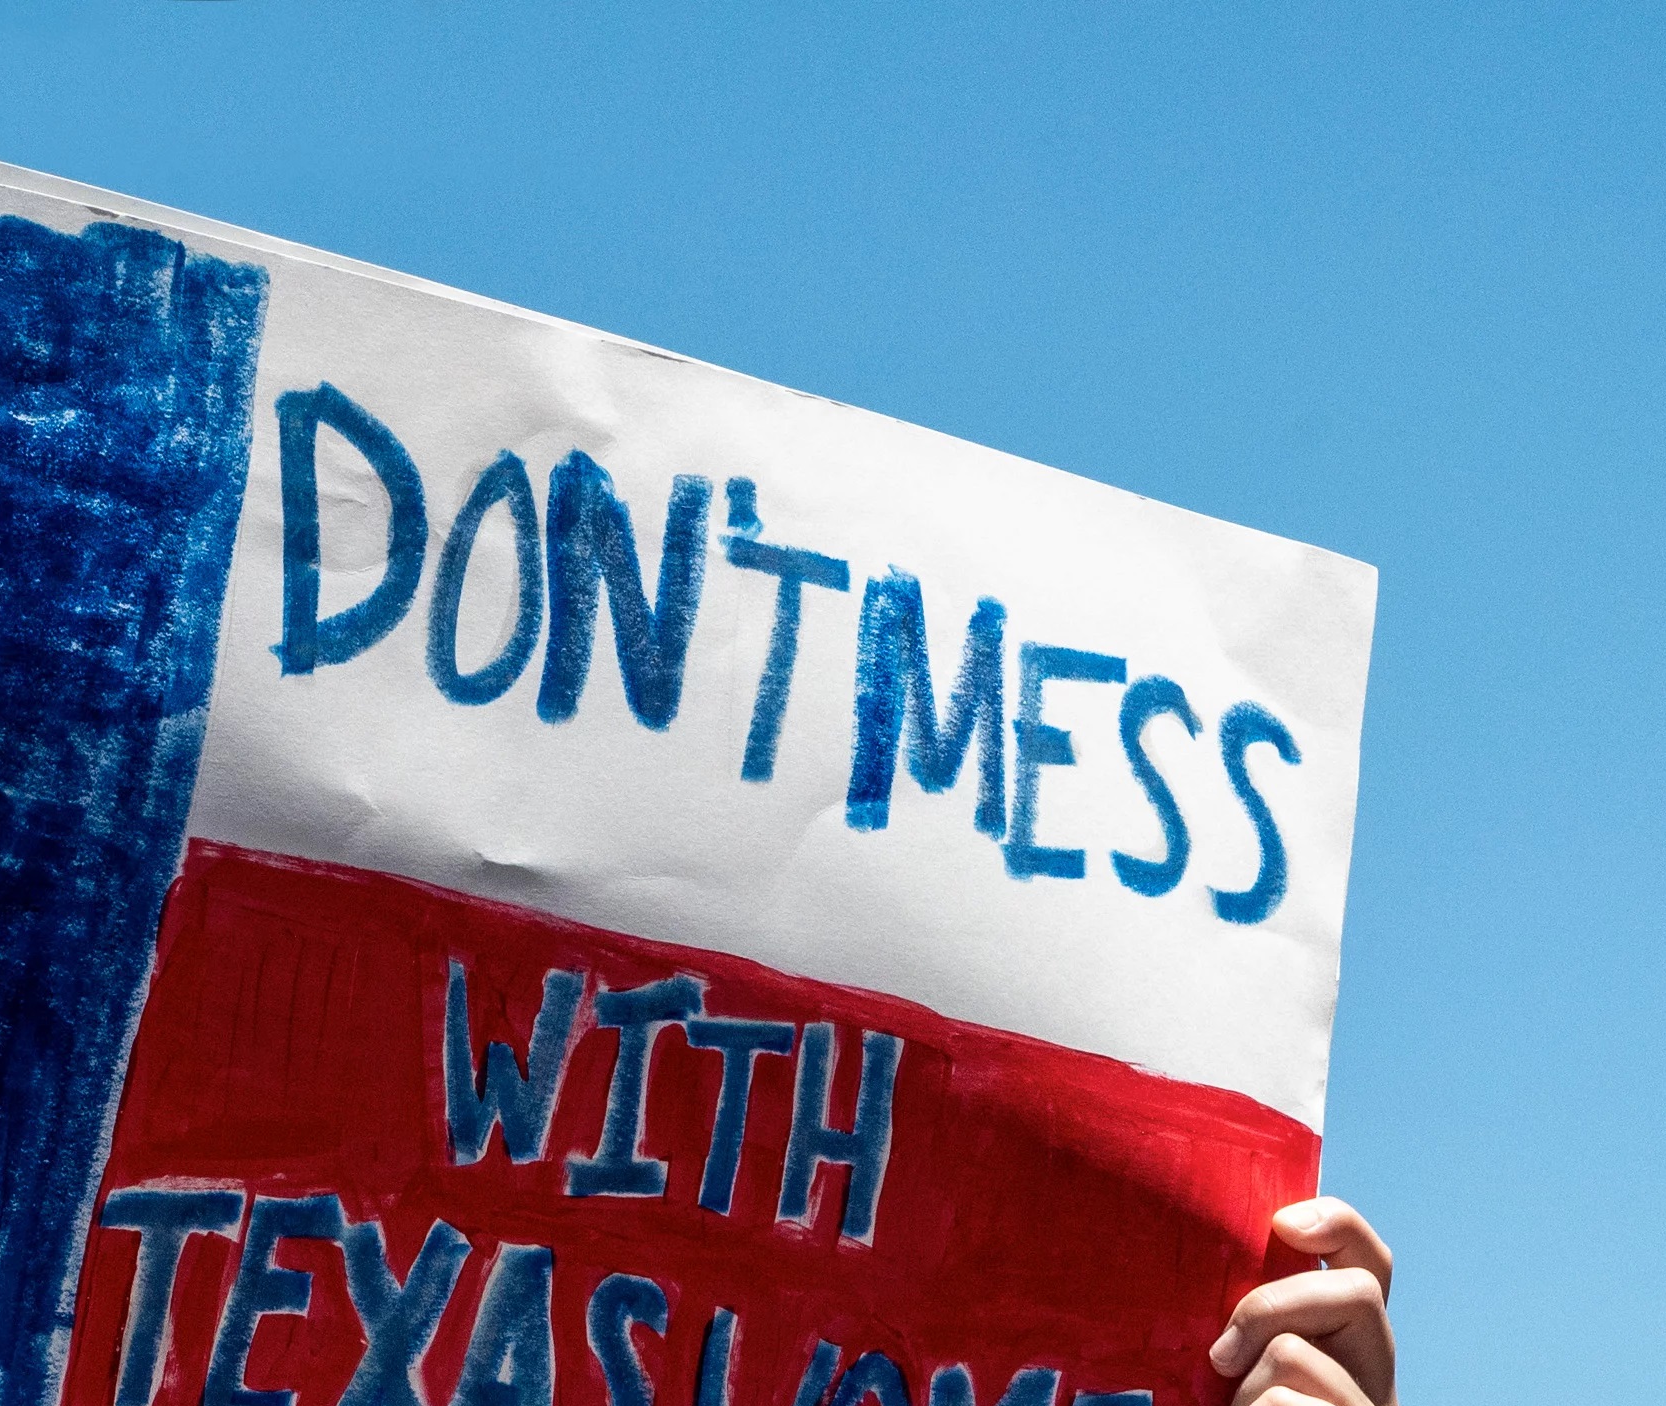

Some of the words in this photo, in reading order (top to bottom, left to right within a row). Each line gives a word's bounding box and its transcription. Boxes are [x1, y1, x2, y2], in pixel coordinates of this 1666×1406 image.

[270, 380, 850, 783] DON'T
[844, 561, 1301, 925] MESS
[445, 956, 903, 1250] WITH
